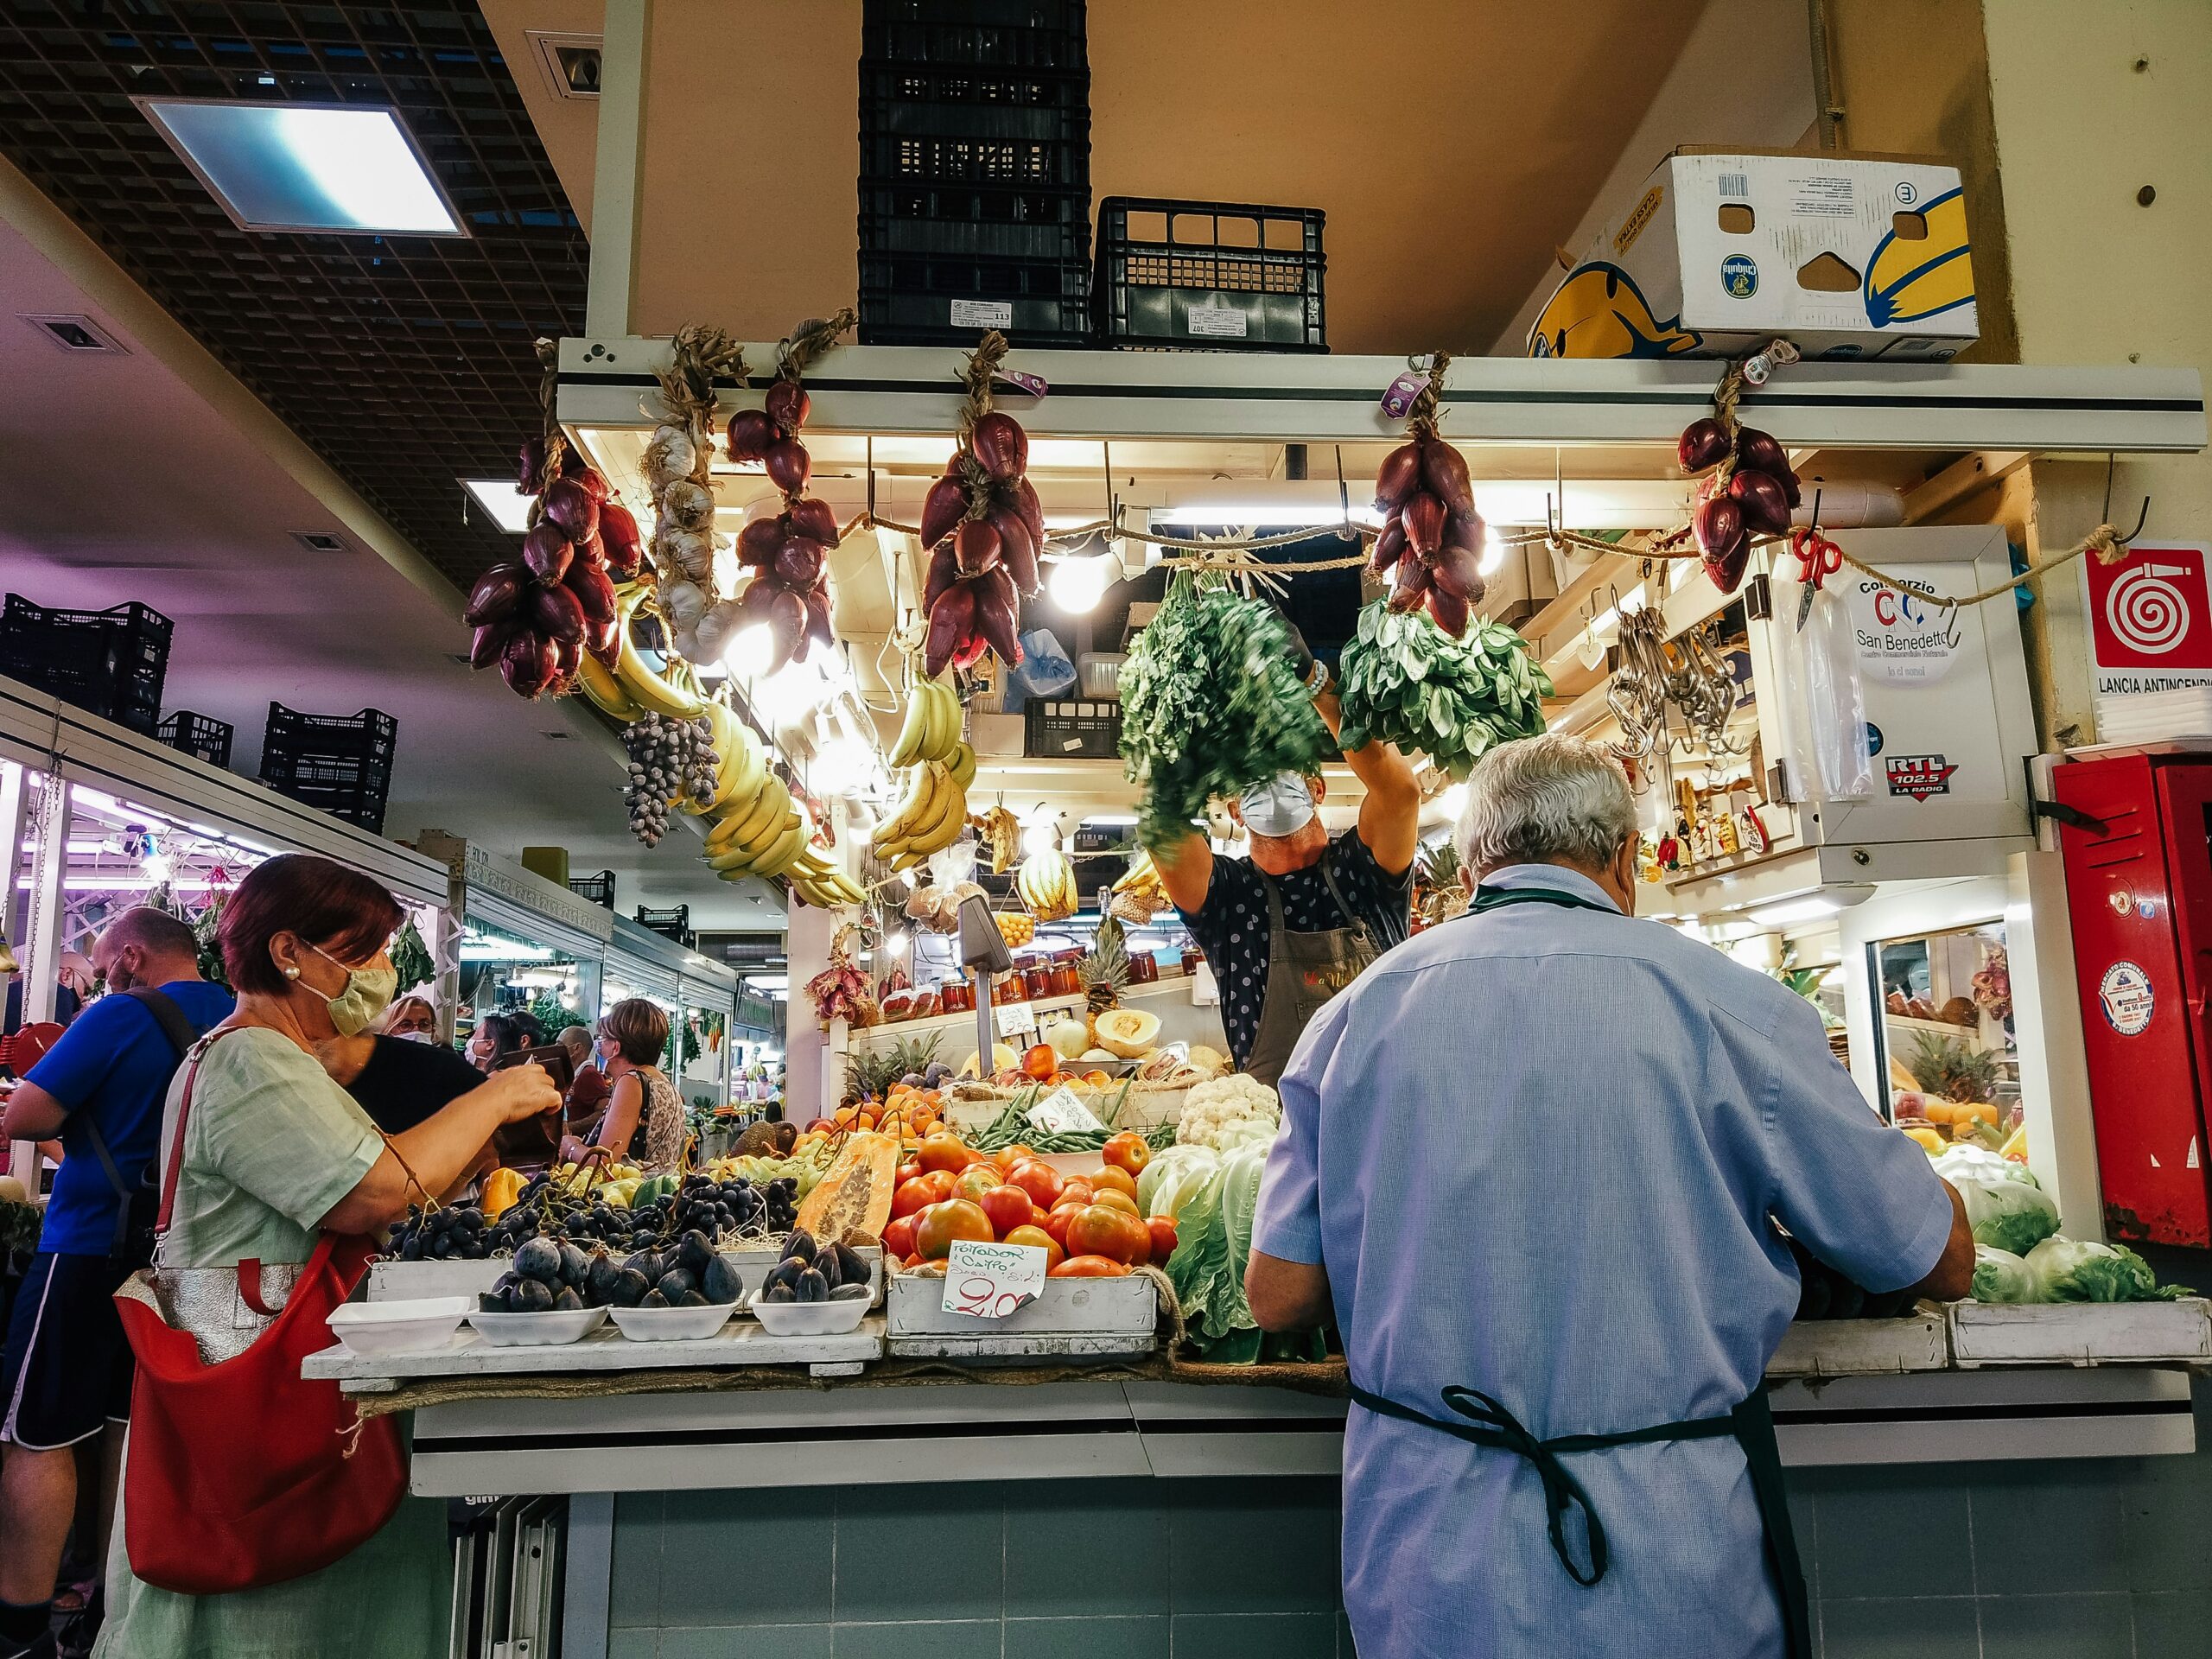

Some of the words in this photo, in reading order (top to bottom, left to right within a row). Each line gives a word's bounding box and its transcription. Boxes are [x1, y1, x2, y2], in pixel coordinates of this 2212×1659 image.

[1637, 193, 1655, 219] CLASS
[1618, 216, 1637, 245] EXTRA
[1722, 262, 1758, 275] Chiquita
[1859, 579, 1936, 594] Conorzio
[1857, 629, 1883, 649] San
[1885, 631, 1947, 651] Benedetto
[1860, 650, 1882, 658] Centro
[1882, 650, 1922, 658] Commerciale
[2098, 677, 2140, 694] LANCIA
[1887, 757, 1943, 772] RTL
[1894, 773, 1940, 785] 102.5
[2101, 963, 2119, 993] MERCATO
[2119, 962, 2151, 985] COMUNALE
[2118, 1015, 2150, 1035] BENEDETTO
